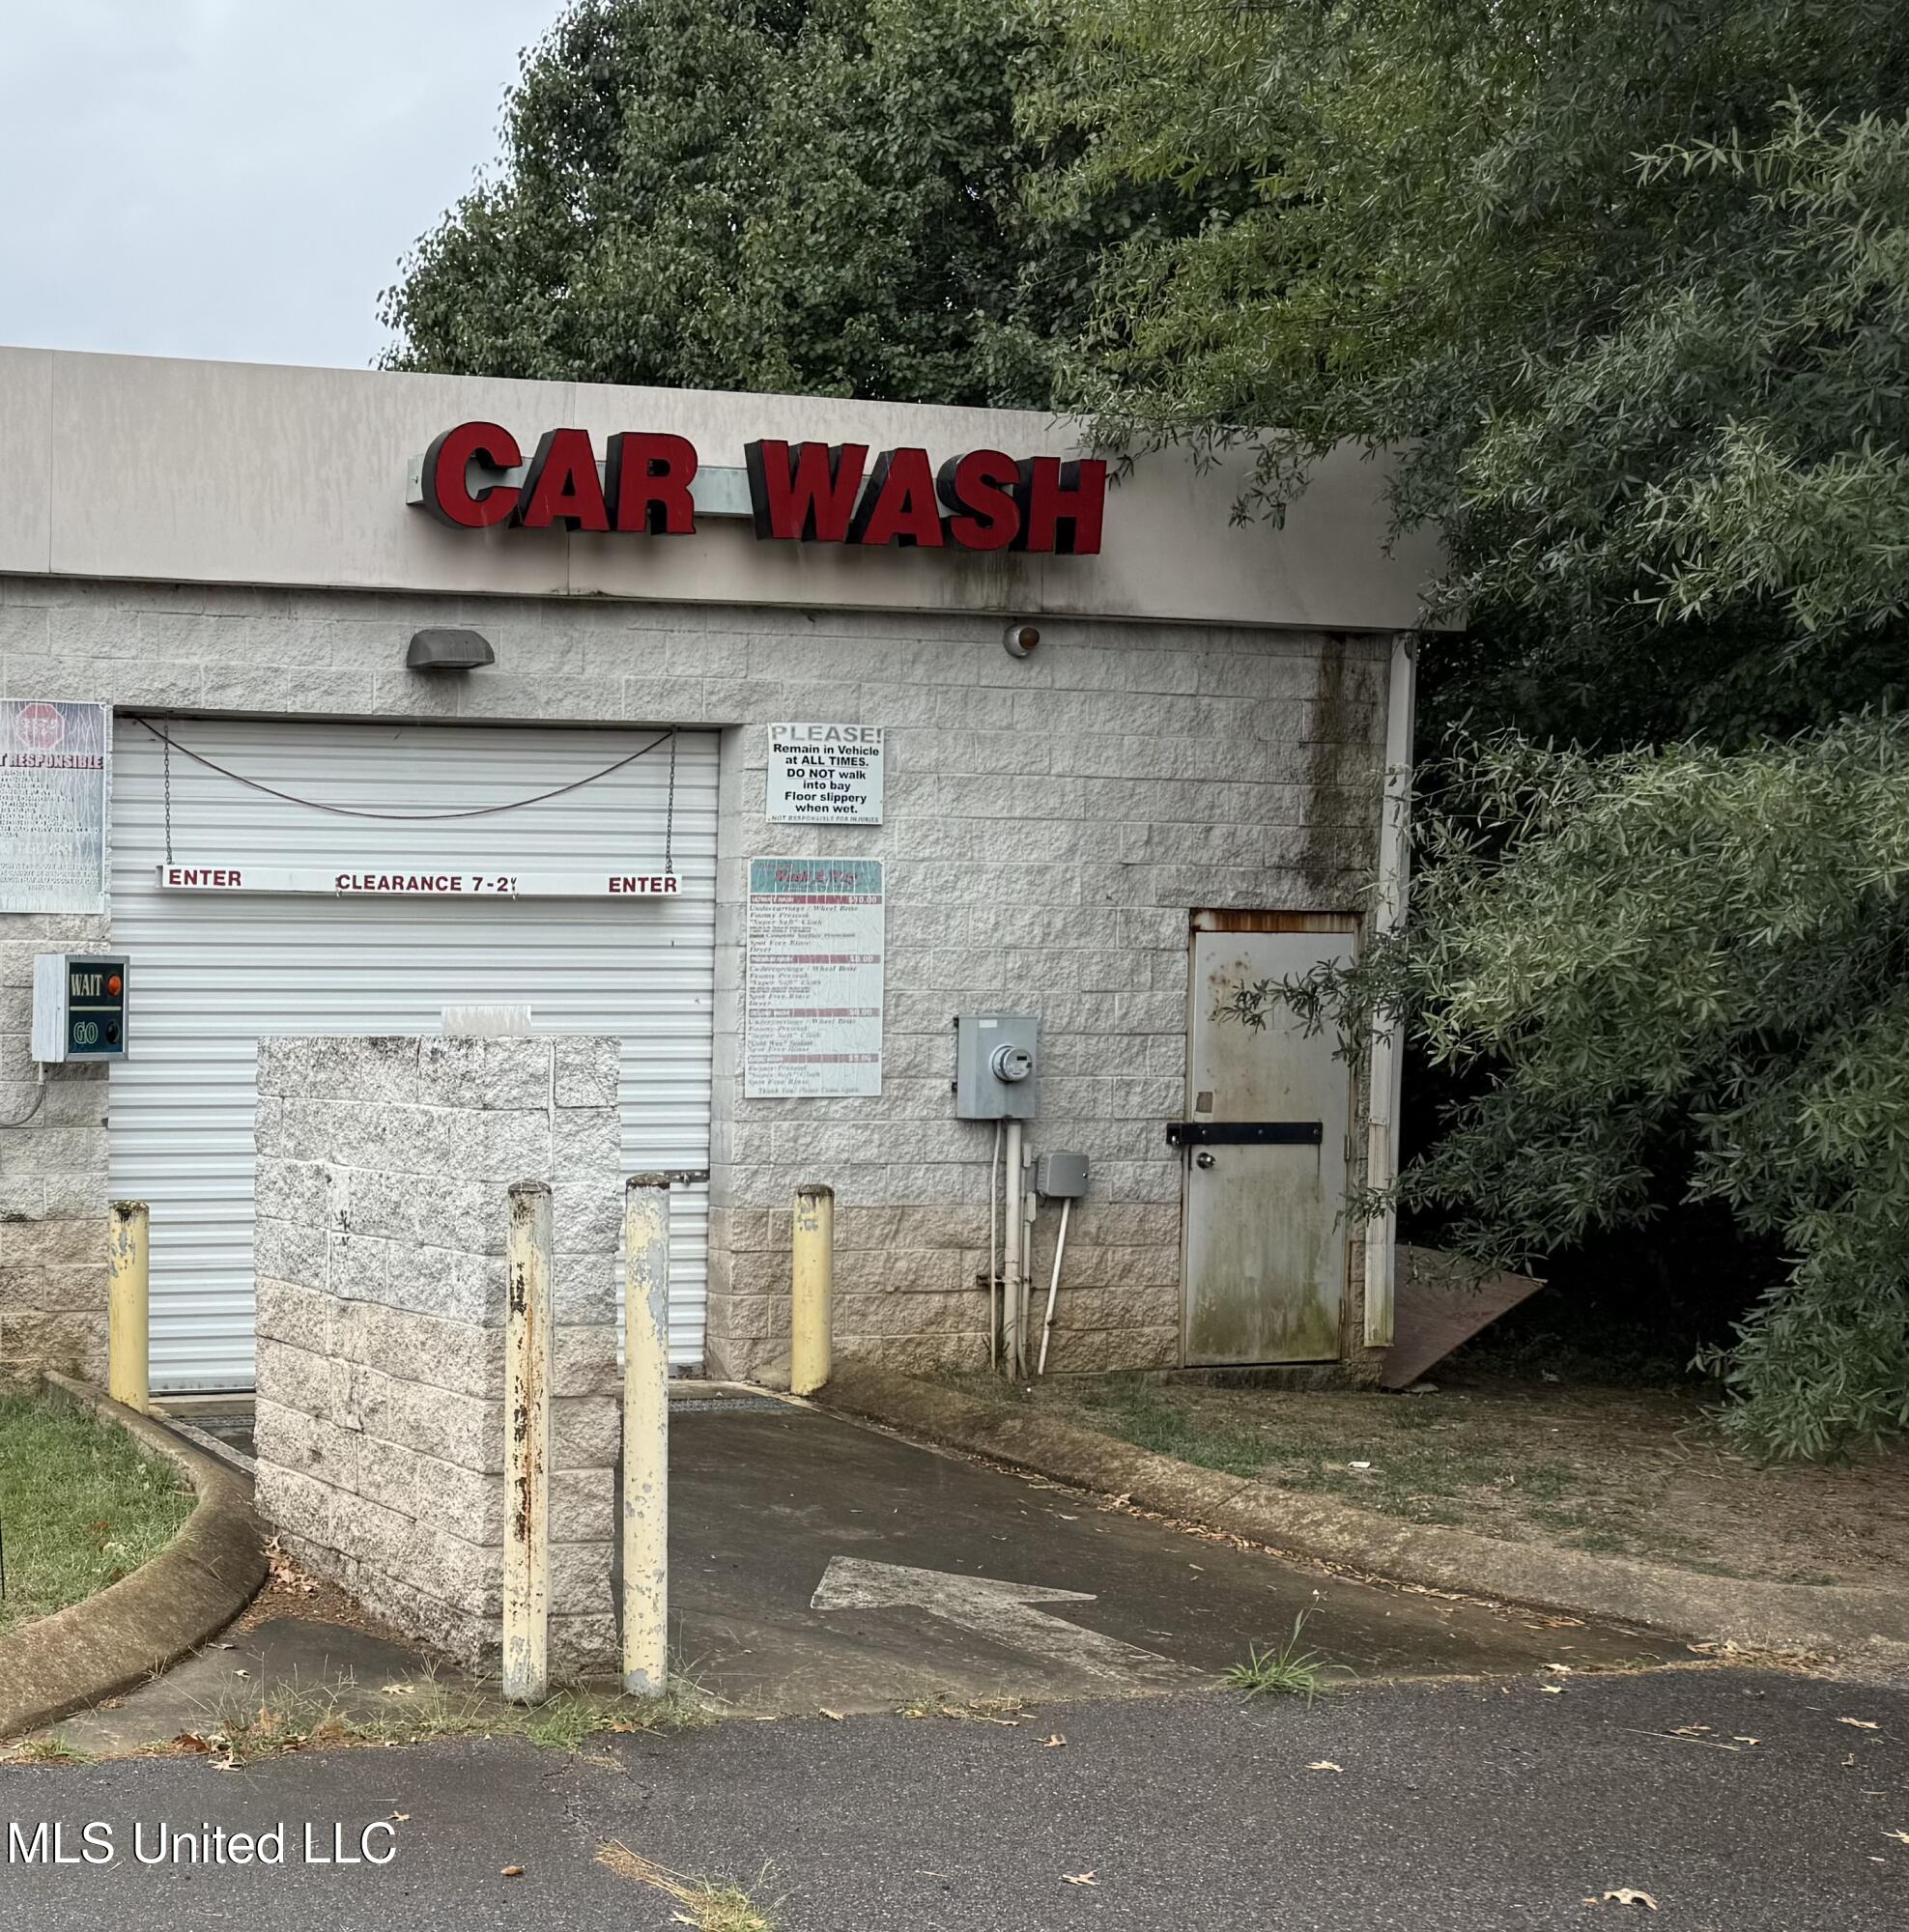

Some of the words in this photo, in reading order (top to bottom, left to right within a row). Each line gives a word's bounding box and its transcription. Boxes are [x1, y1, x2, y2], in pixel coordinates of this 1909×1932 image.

[422, 421, 698, 534] CAR
[744, 439, 1107, 555] WASH
[772, 725, 882, 744] PLEASE!
[773, 744, 819, 753] Remain
[824, 745, 834, 754] in
[838, 746, 879, 755] Vehicle
[10, 753, 103, 770] RESPONSIBLE
[785, 756, 798, 765] at
[801, 755, 825, 765] ALL
[829, 756, 869, 766] TIMES.
[787, 768, 805, 778] DO
[810, 769, 836, 779] NOT
[839, 770, 867, 780] walk
[803, 781, 826, 789] into
[830, 781, 851, 792] bay
[784, 791, 817, 801] Floor
[820, 792, 867, 805] slippery
[795, 803, 829, 813] when
[833, 805, 858, 813] wet.
[168, 868, 242, 886] ENTER
[337, 874, 462, 892] CLEARANCE
[609, 876, 677, 893] ENTER
[71, 974, 102, 996] WAIT
[73, 1021, 99, 1043] GO
